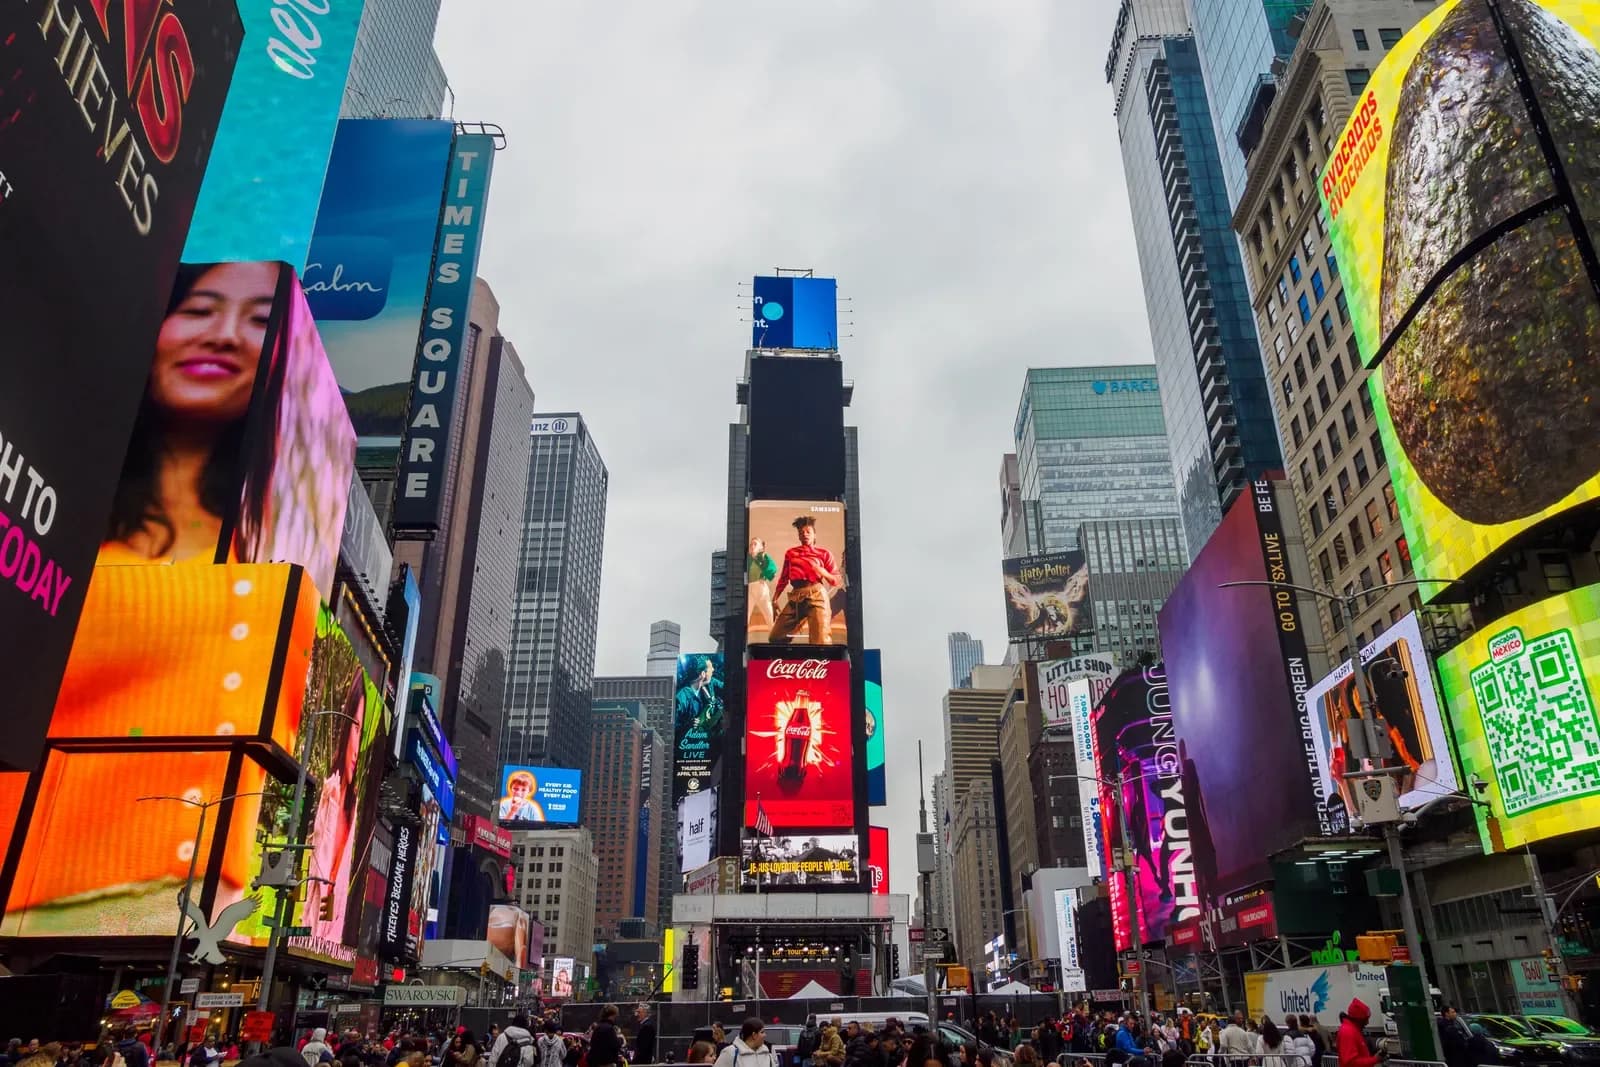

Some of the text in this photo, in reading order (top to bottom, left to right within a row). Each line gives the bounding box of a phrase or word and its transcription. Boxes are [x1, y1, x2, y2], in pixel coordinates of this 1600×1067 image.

[1322, 90, 1378, 199] AVOCADOS
[1329, 117, 1383, 221] AVOCADOS
[405, 151, 479, 498] TIMES SQUARE
[0, 432, 57, 536] H TO
[1257, 496, 1273, 513] BE
[1044, 563, 1072, 577] Potter
[1275, 591, 1292, 610] TO
[1280, 611, 1296, 632] GO
[1046, 659, 1112, 684] LITTLE SHOP
[1287, 657, 1308, 712] SCREEN
[685, 728, 708, 739] Adam
[1300, 717, 1314, 740] BIG
[679, 738, 711, 750] Sandler
[683, 751, 706, 759] LIVE
[1305, 743, 1320, 775] THE
[690, 817, 704, 836] half
[801, 861, 823, 872] PEOPLE
[824, 860, 835, 871] WE
[386, 826, 410, 943] THIEVES BECOME HEROES
[1355, 972, 1385, 981] United
[386, 989, 456, 1001] SWAROVSKI
[1280, 987, 1311, 1013] United
